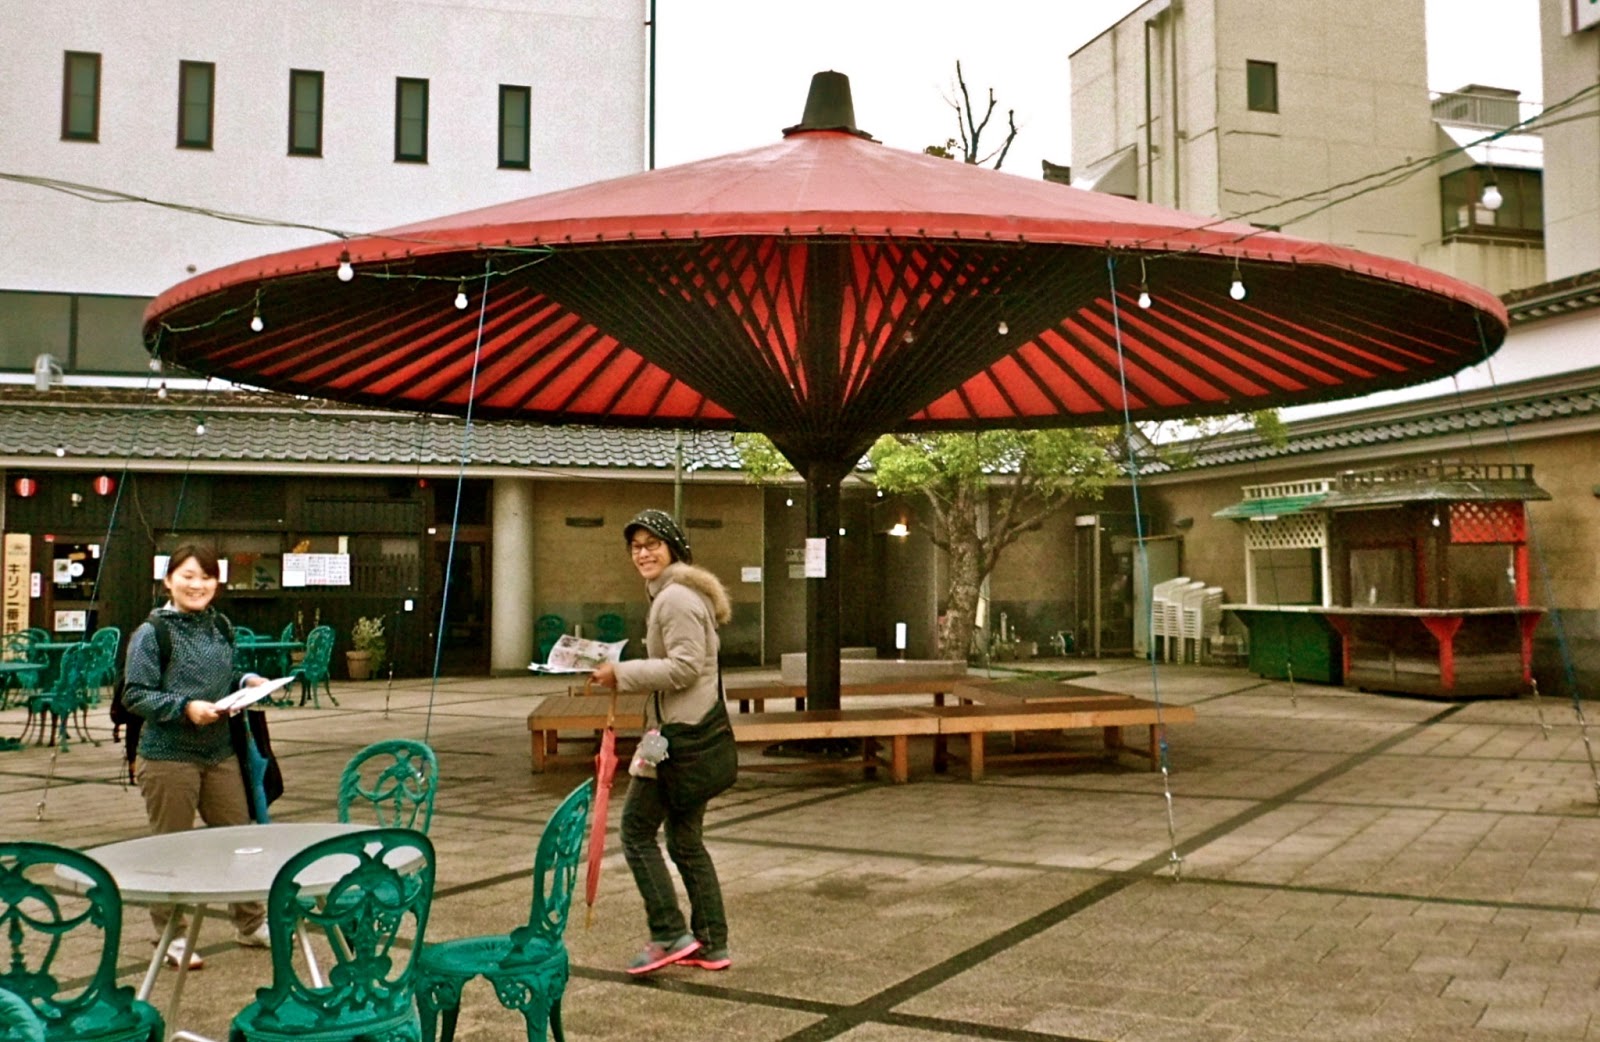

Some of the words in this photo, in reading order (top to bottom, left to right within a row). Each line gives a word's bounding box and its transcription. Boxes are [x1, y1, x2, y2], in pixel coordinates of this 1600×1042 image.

[7, 563, 20, 635] キリン一番搾
